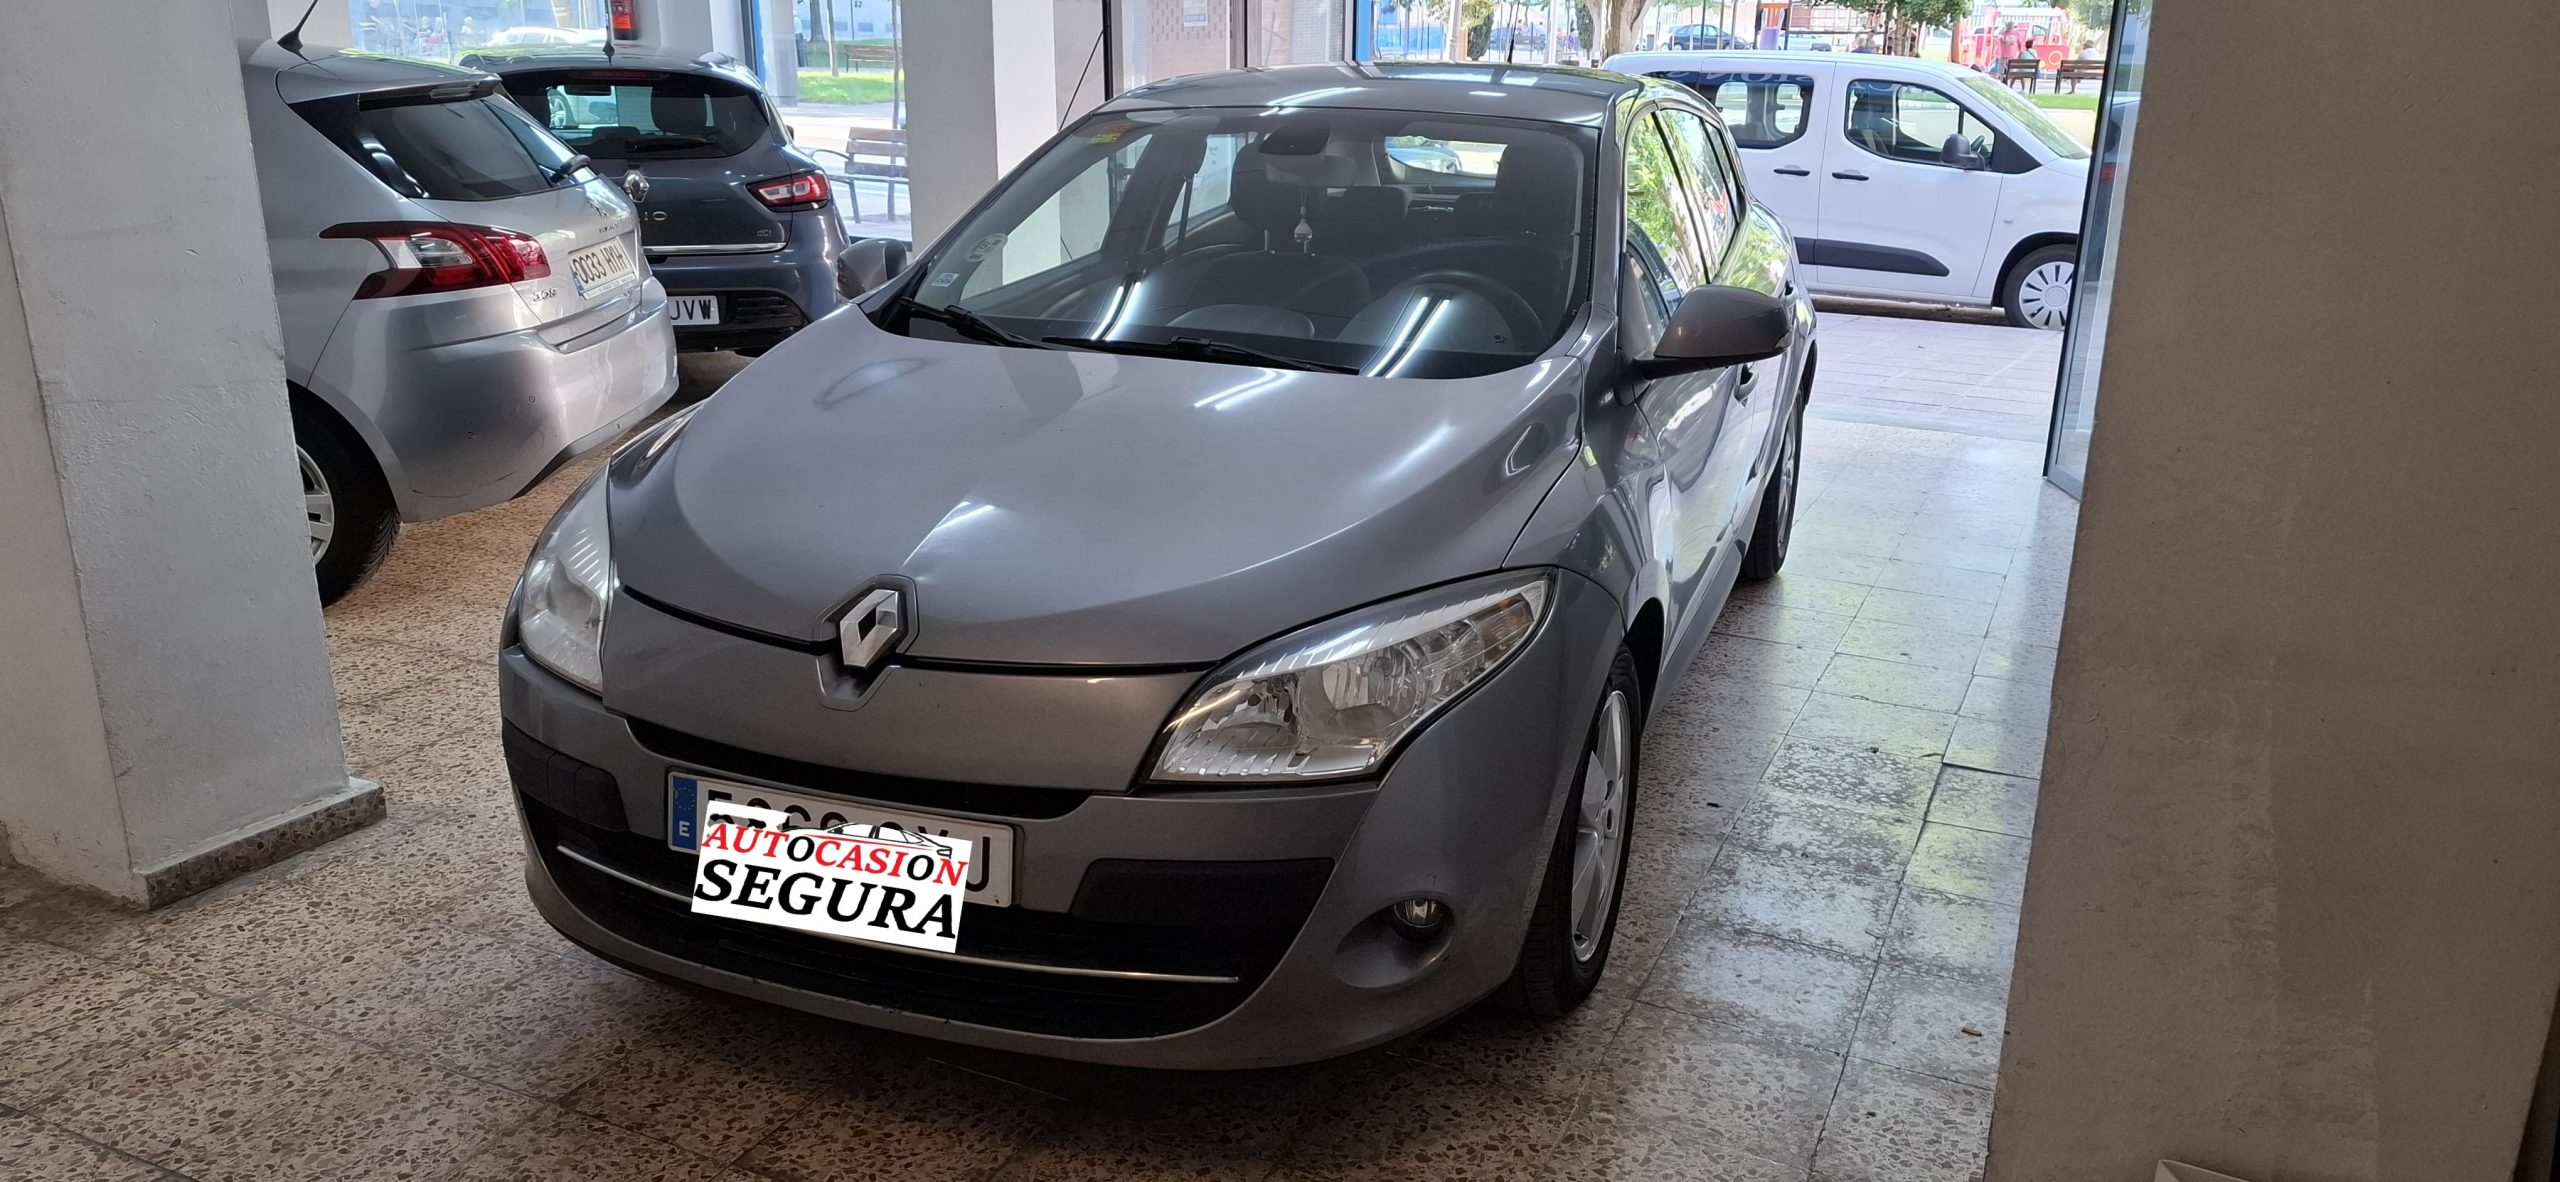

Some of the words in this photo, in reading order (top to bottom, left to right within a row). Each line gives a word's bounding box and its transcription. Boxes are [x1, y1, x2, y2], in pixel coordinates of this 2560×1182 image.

[573, 252, 607, 284] 0033
[533, 287, 558, 302] 308
[670, 299, 711, 320] JVW
[679, 820, 692, 838] E
